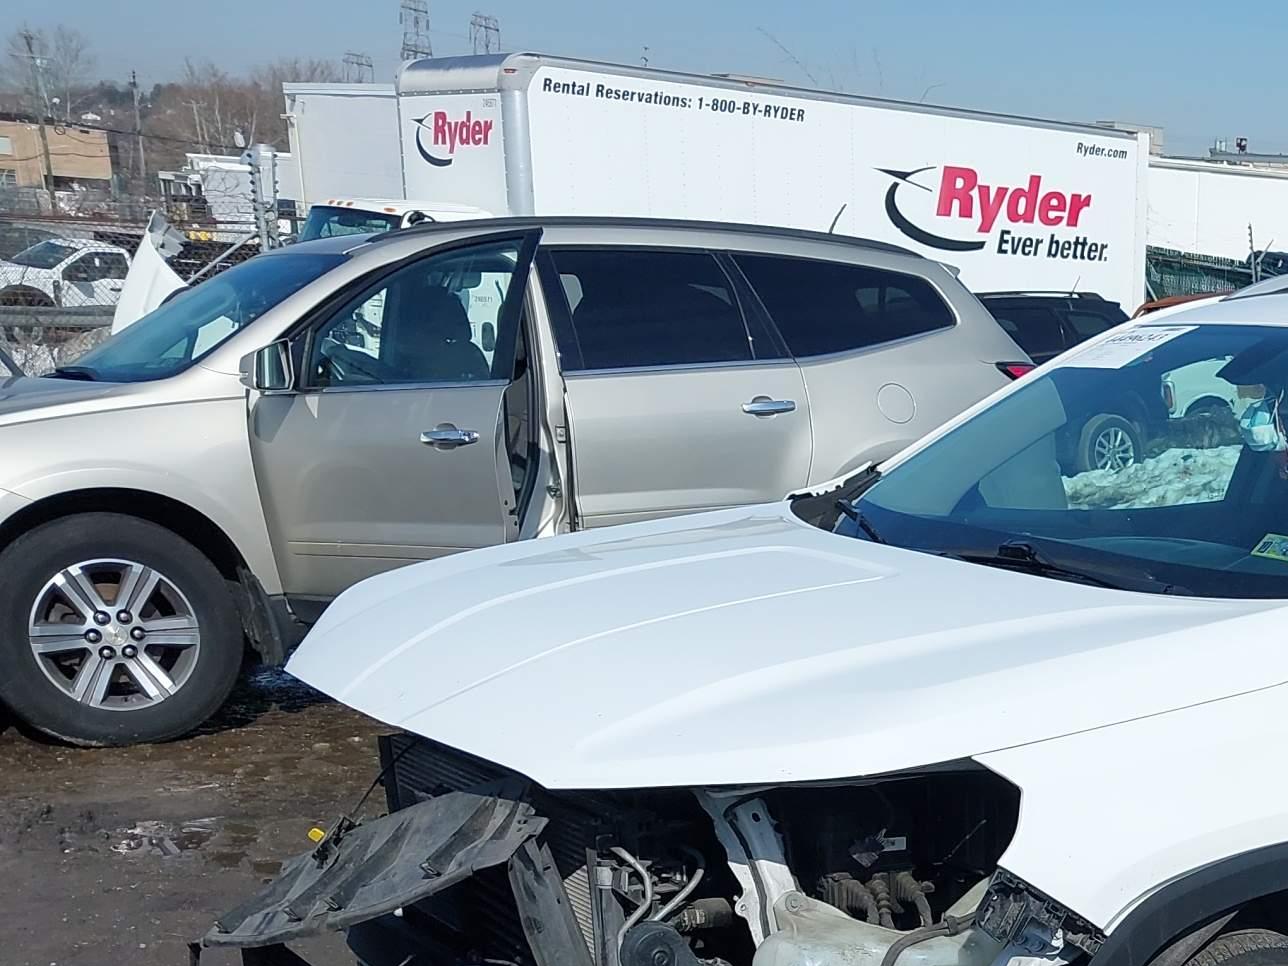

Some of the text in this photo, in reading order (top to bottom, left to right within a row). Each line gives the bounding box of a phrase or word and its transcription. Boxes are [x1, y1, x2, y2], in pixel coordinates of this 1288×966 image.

[543, 77, 806, 122] Rental Reservations: 1-800-BY-RYDER
[433, 110, 493, 154] Ryder
[1076, 142, 1128, 160] Ryder.com
[936, 165, 1092, 233] Ryder
[996, 230, 1108, 262] Ever better.
